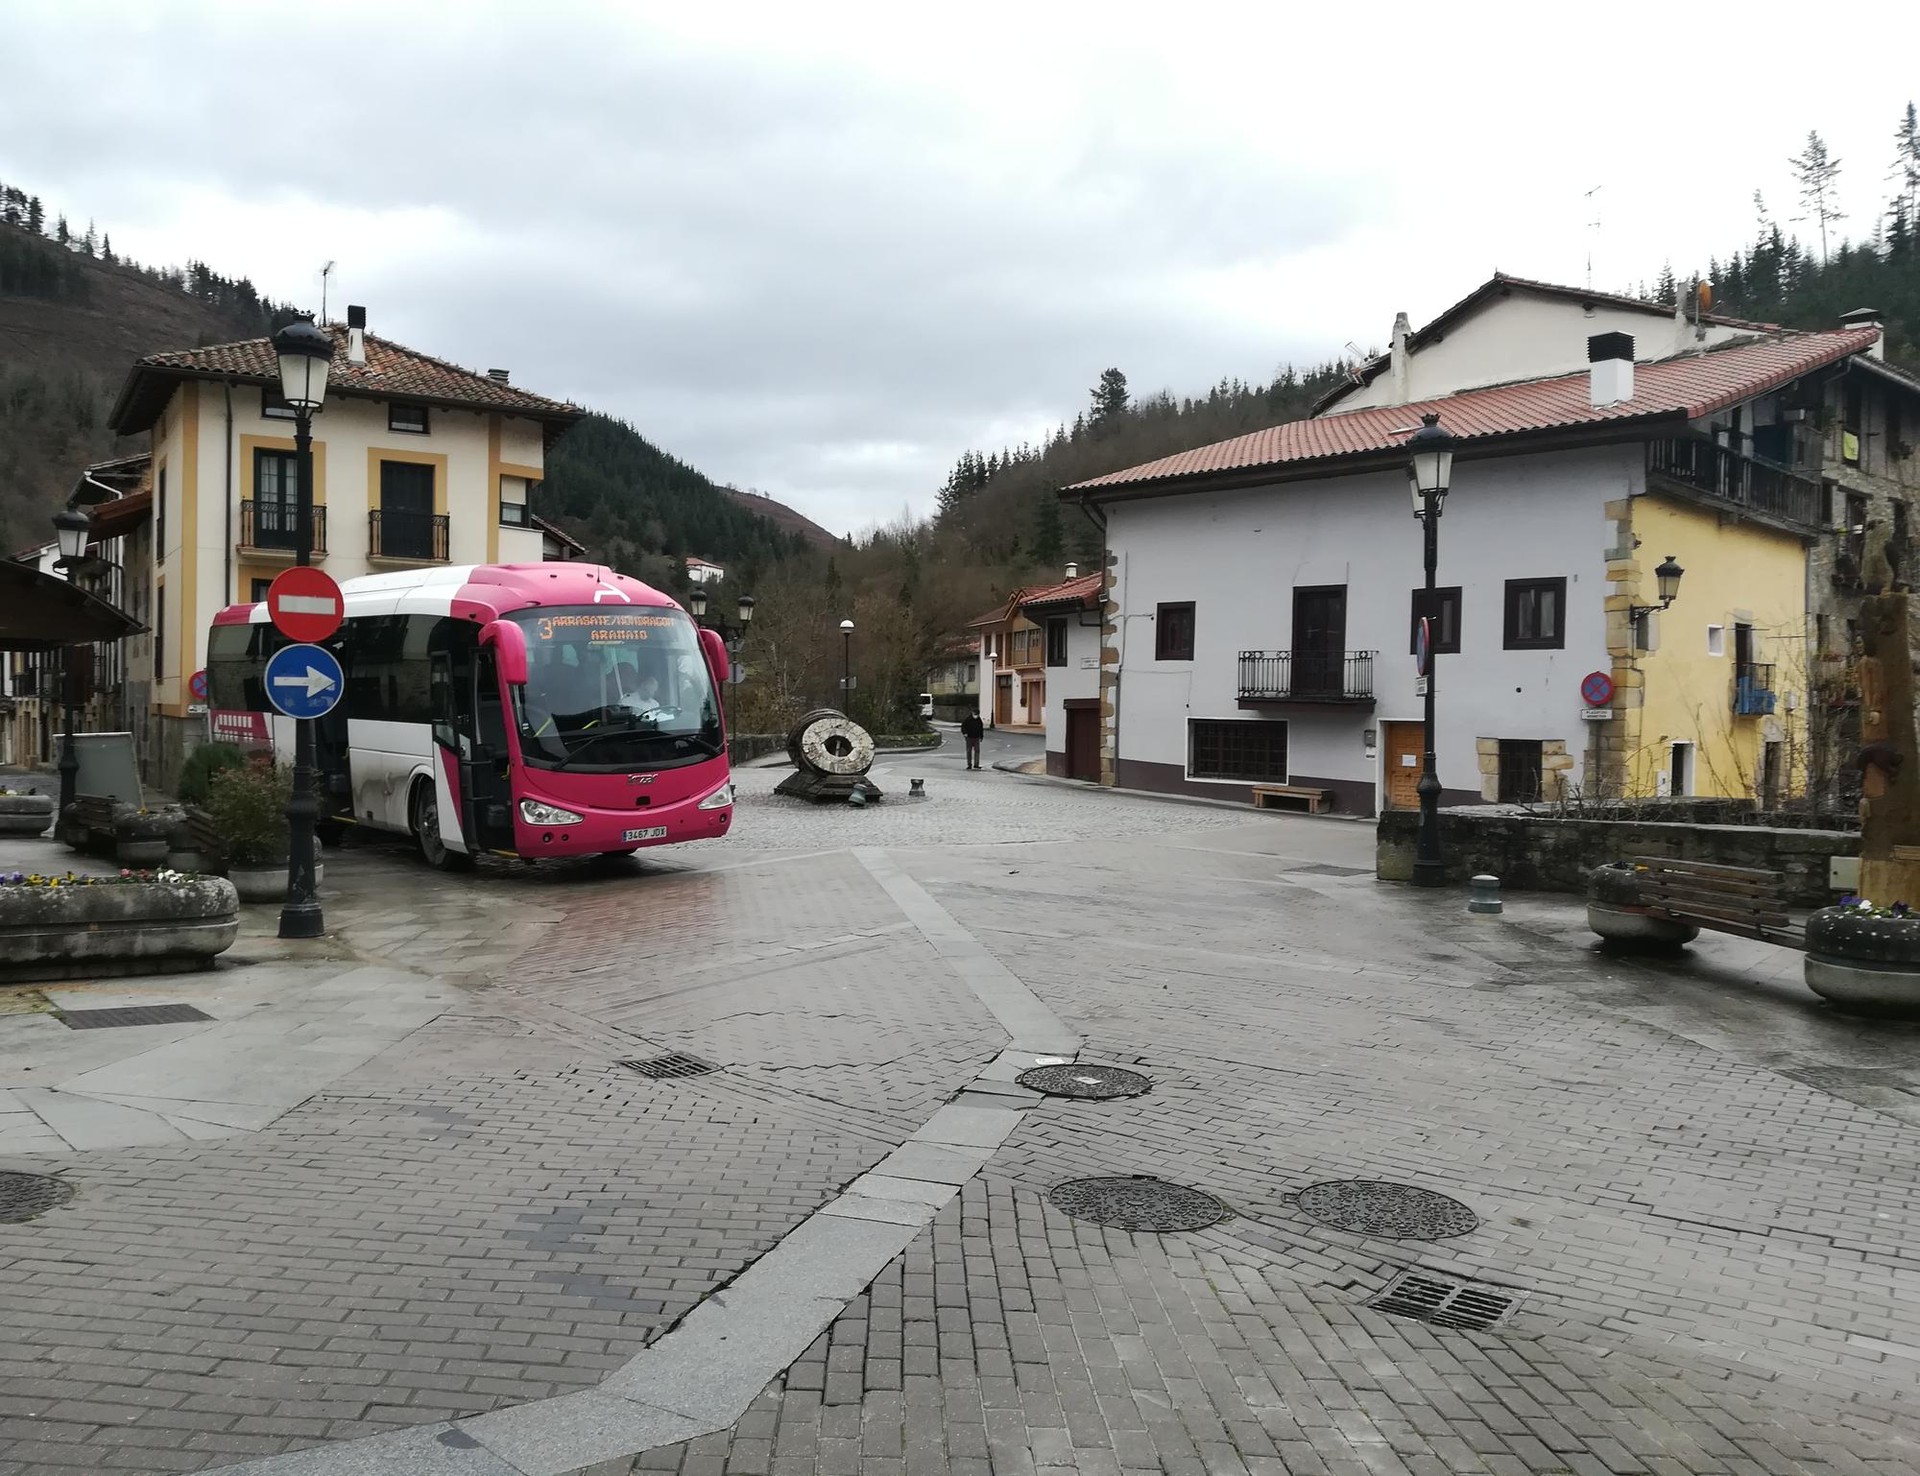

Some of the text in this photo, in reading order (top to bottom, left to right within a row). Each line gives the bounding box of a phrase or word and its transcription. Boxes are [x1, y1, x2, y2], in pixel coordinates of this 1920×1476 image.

[537, 617, 553, 640] 3
[591, 630, 648, 640] ARAMAIO
[627, 829, 649, 840] 3467
